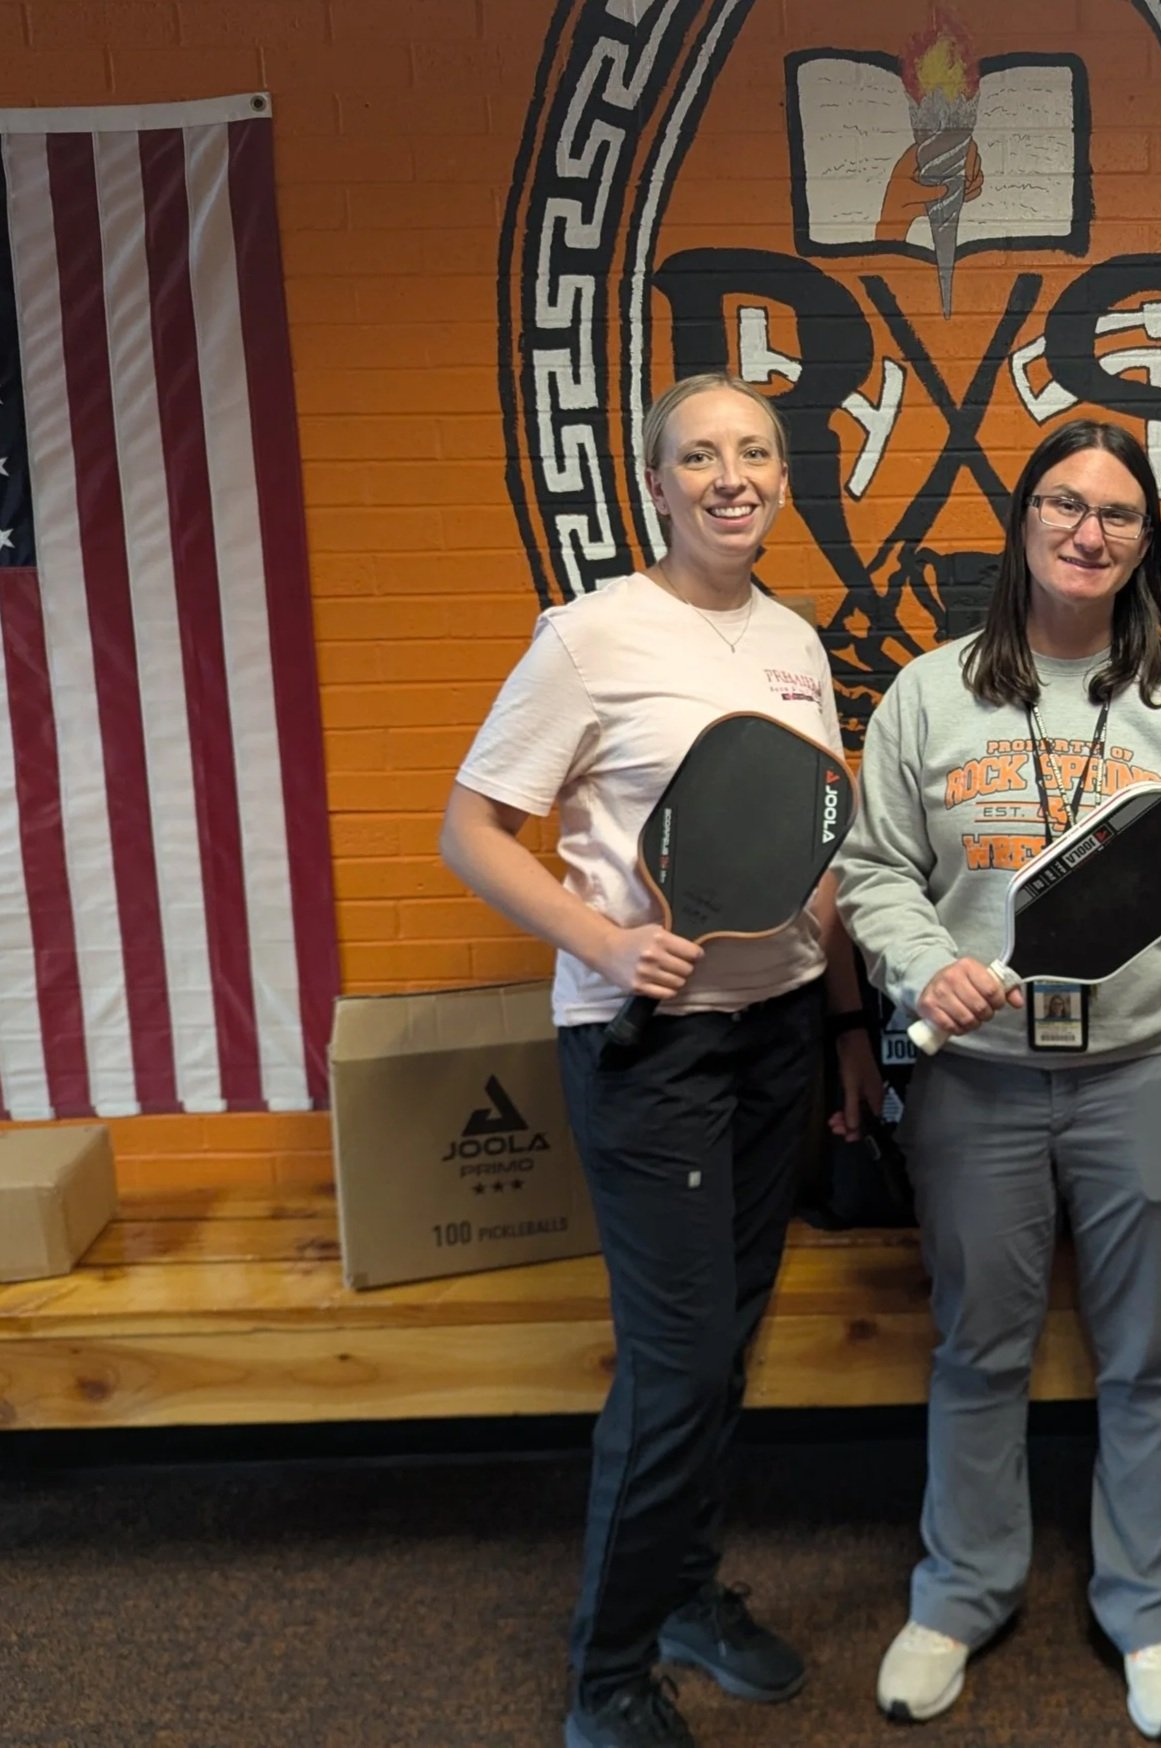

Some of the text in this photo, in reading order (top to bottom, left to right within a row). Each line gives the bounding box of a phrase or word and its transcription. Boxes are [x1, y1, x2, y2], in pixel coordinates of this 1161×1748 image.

[944, 753, 1030, 810] ROCK
[820, 784, 839, 844] JOOLA
[983, 806, 1026, 818] EST.
[1065, 837, 1097, 866] JOOLA
[441, 1130, 551, 1162] JOOLA
[459, 1157, 535, 1179] PRIMO
[432, 1216, 570, 1248] 100 PICKLEBALLS
